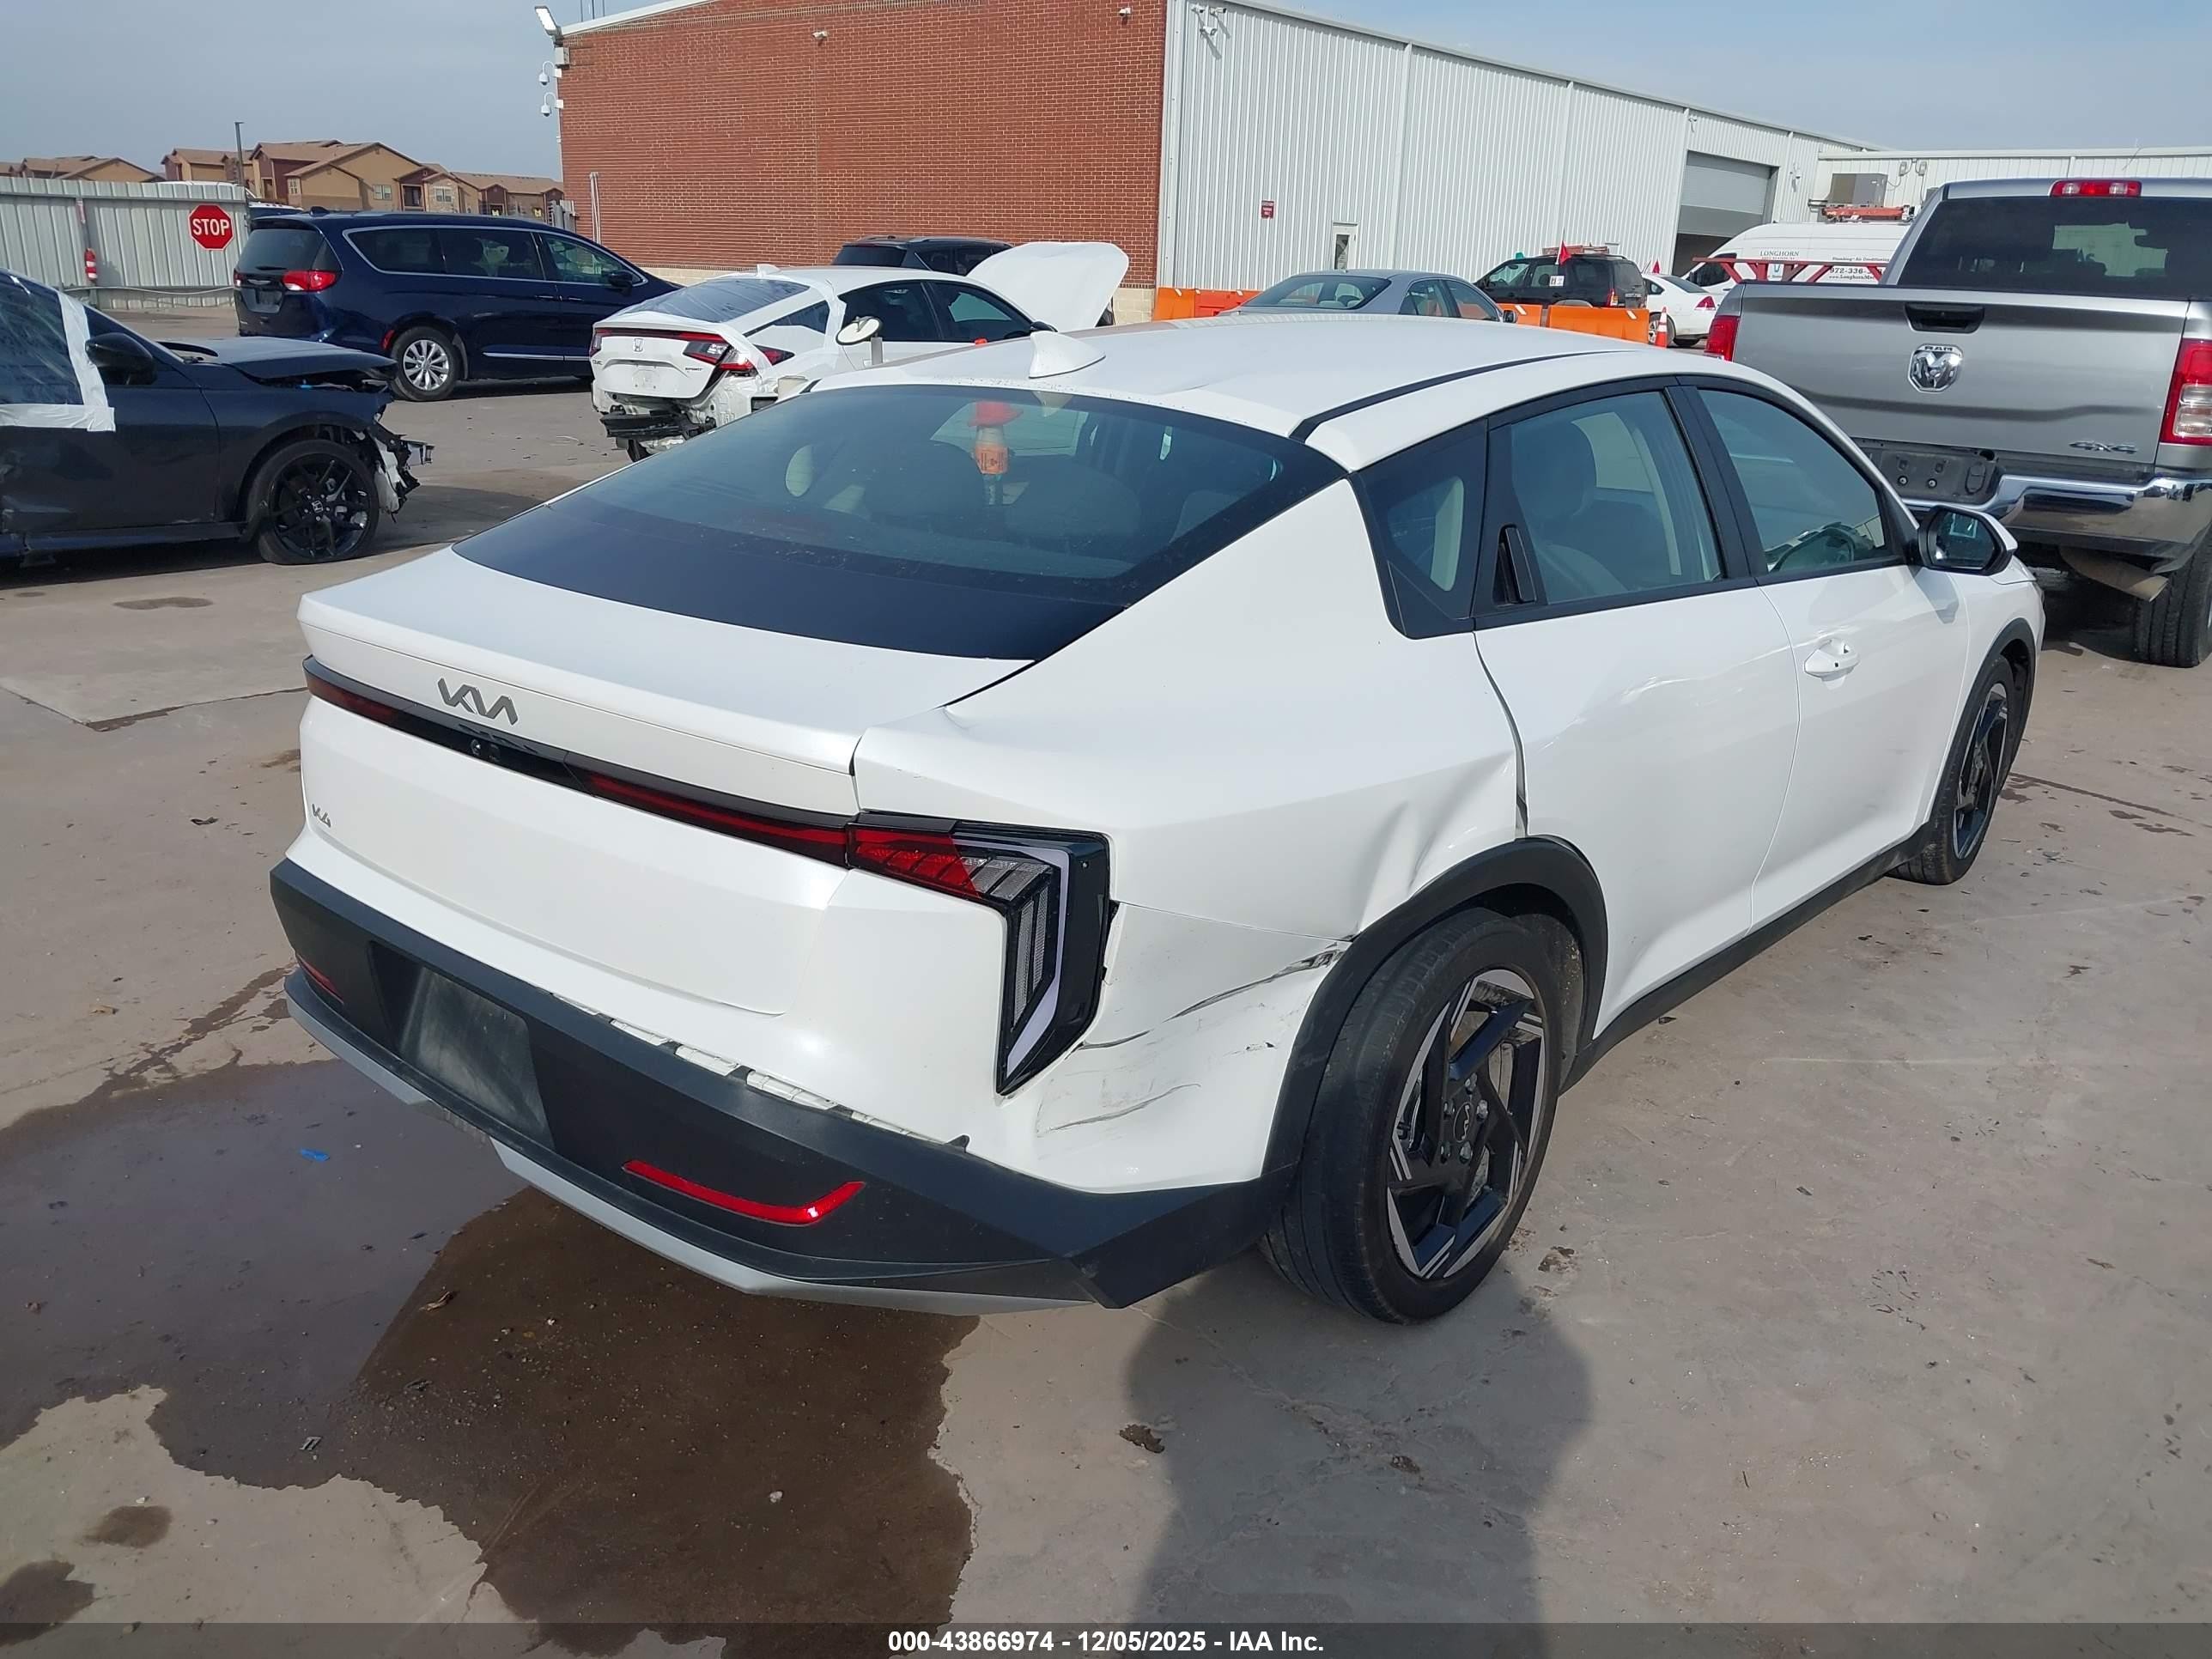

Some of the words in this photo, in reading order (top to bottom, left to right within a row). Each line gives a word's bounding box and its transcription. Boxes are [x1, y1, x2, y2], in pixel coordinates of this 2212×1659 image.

[192, 218, 229, 236] STOP
[437, 678, 519, 726] KIA
[312, 803, 331, 829] K4
